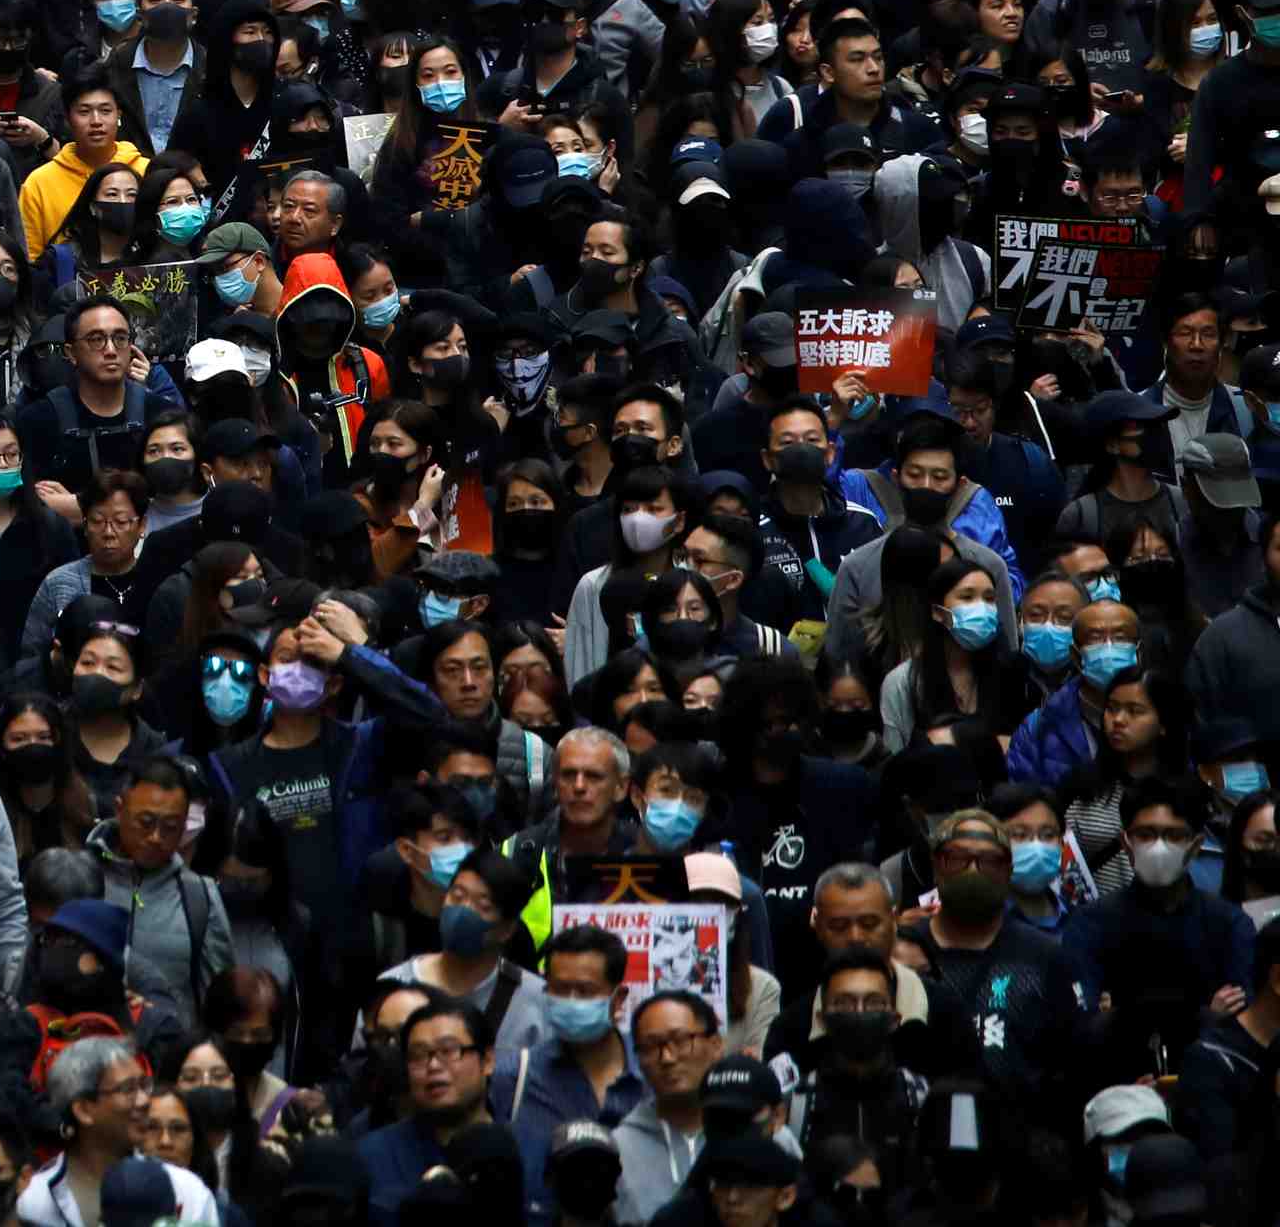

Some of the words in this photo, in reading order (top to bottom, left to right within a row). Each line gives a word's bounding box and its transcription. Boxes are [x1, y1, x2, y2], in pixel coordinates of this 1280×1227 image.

[1040, 243, 1098, 276] 我們
[1024, 273, 1082, 329] 不
[797, 308, 894, 338] 五大訴求
[797, 339, 893, 370] 堅持到底
[592, 862, 665, 904] 天
